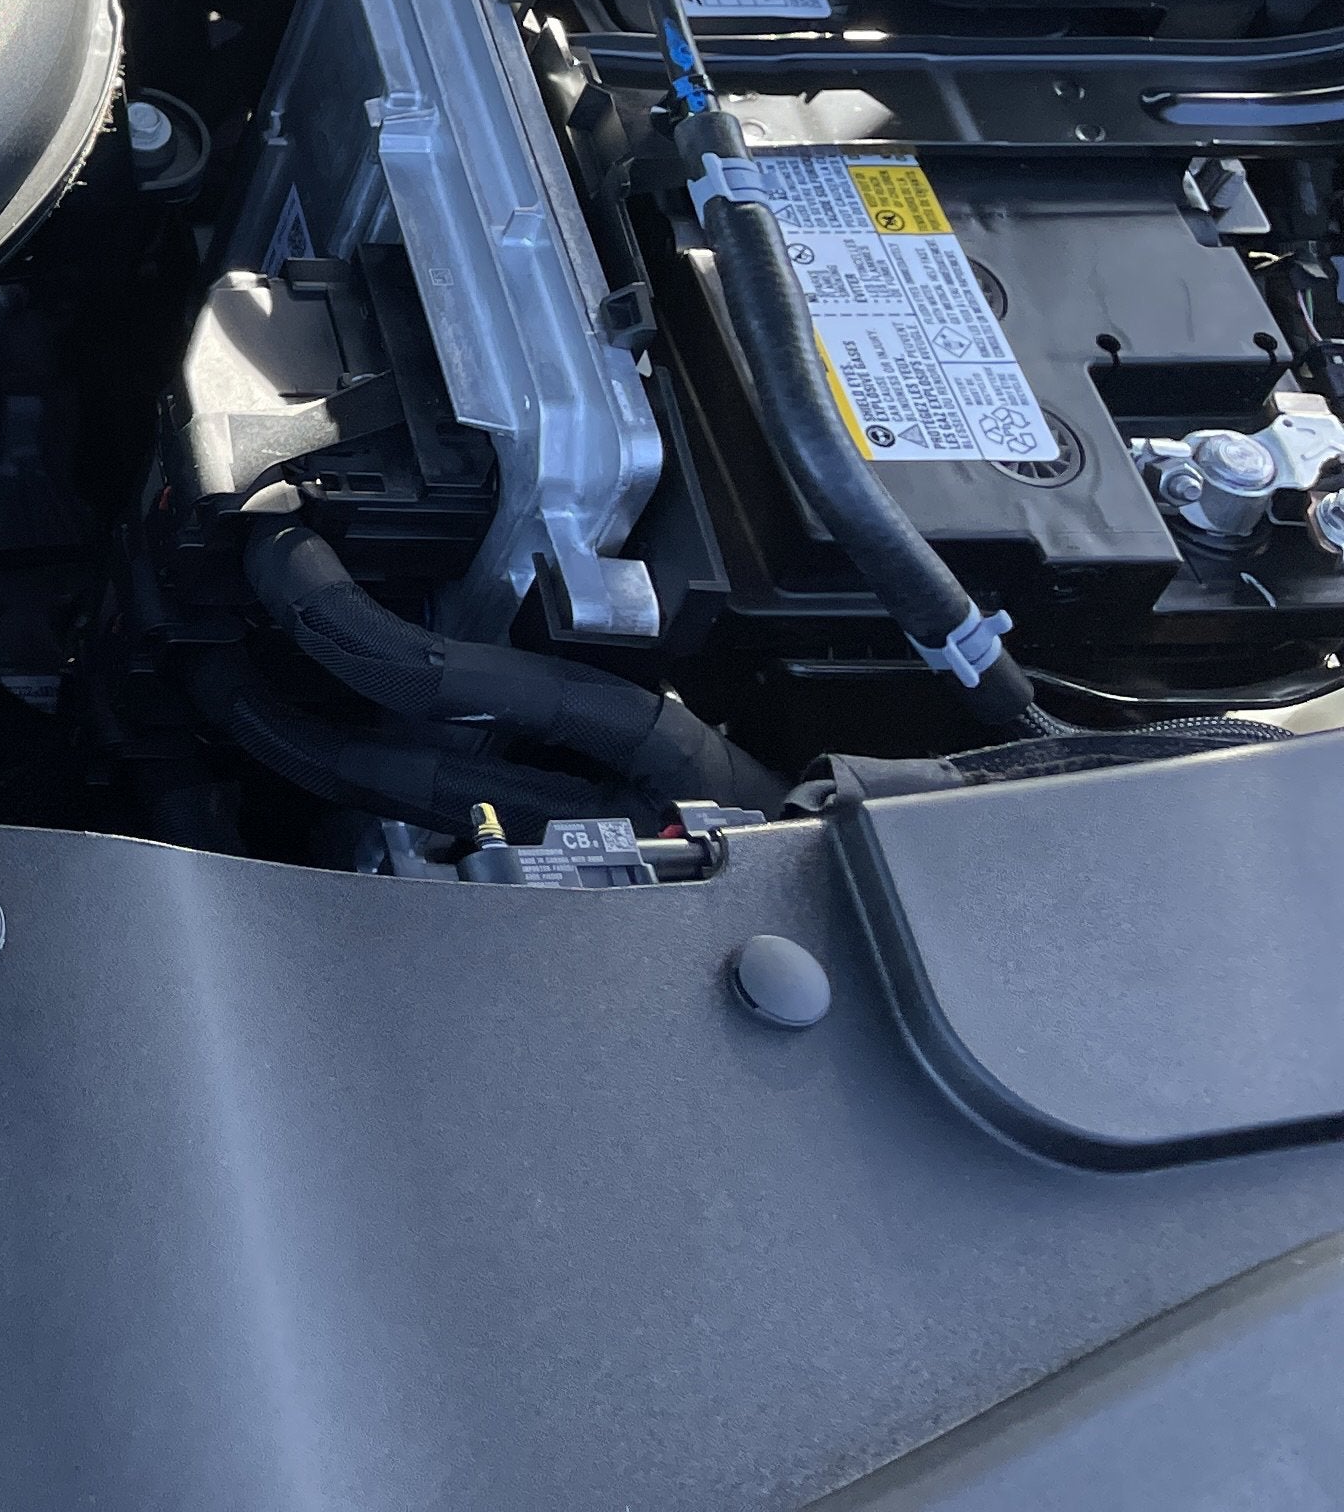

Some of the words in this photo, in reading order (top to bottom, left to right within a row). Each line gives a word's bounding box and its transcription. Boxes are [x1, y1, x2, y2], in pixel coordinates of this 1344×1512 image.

[841, 340, 866, 369] GASES
[890, 322, 919, 358] PEUVENT
[878, 361, 895, 373] OR
[923, 362, 949, 395] RENDRE
[855, 372, 890, 421] EXPLOSIVE
[872, 376, 895, 402] CAUSE
[885, 375, 918, 421] BLINDNESS
[903, 383, 923, 398] LES
[908, 361, 942, 408] EXPLOSIFS
[850, 390, 876, 421] SHIELD
[885, 405, 904, 421] CAN
[939, 397, 955, 409] OU
[909, 401, 946, 448] PROTÉGEZ
[931, 410, 952, 430] GAZ
[945, 411, 973, 448] BLESSER
[941, 432, 960, 448] LES
